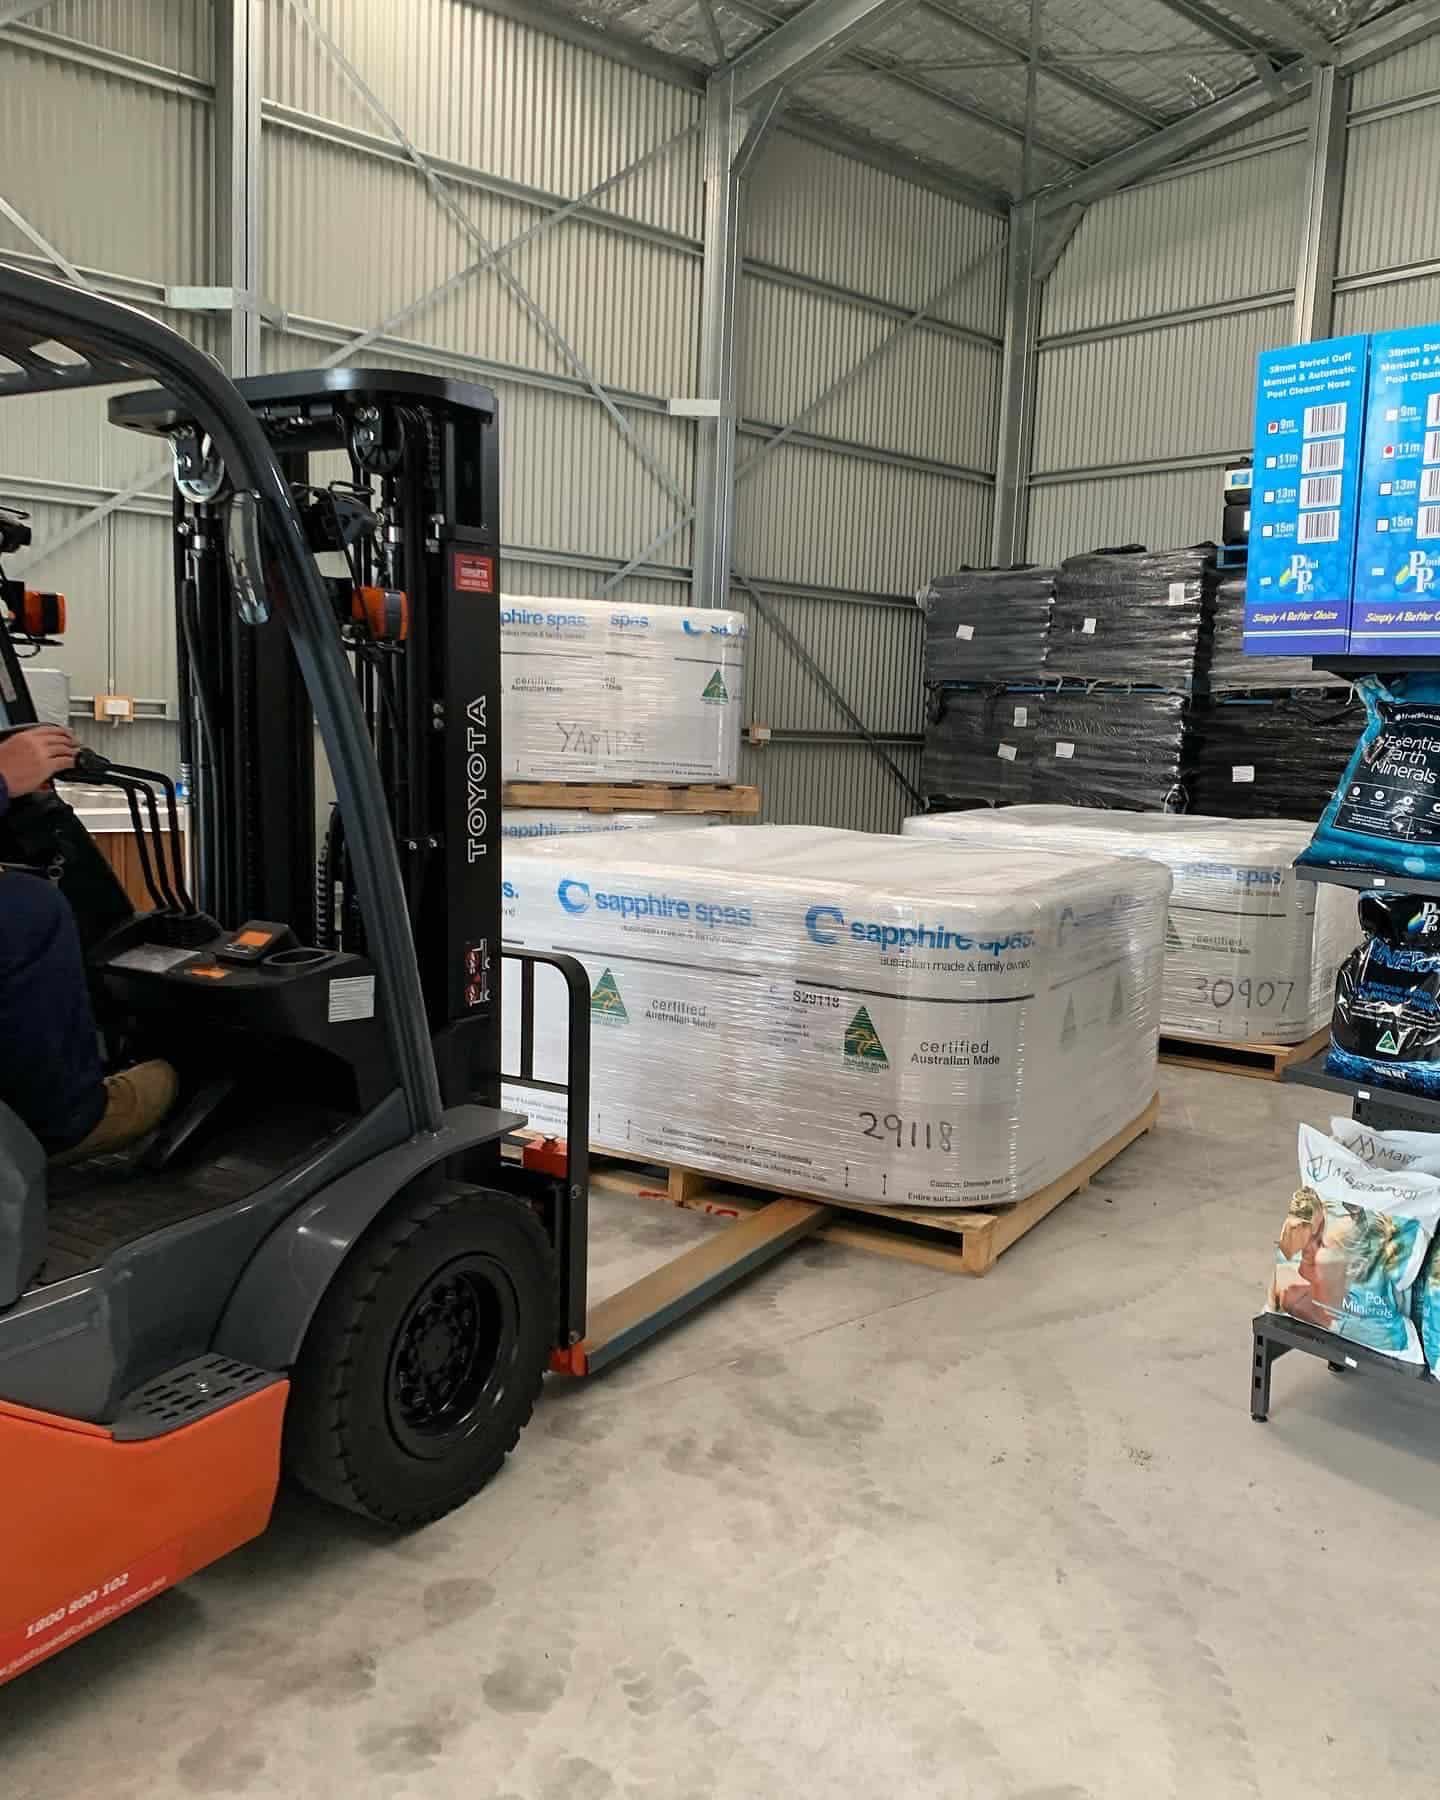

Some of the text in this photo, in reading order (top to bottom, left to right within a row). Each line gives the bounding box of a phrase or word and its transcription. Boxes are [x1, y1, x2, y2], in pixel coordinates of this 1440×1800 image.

[1299, 357, 1329, 369] Swivel
[1332, 352, 1352, 363] Cuff
[1381, 359, 1420, 372] Manual
[1423, 357, 1430, 366] &
[1264, 365, 1357, 388] Manual & Automatic
[1385, 374, 1408, 385] Pool
[1266, 380, 1351, 399] Pool Cleaner Hose
[1400, 406, 1416, 415] 9m
[1280, 419, 1295, 430] 9m
[1398, 442, 1420, 453] 11m
[1279, 453, 1298, 464] 11m
[1394, 480, 1416, 490] 13m
[1275, 522, 1295, 533] 15m
[1391, 516, 1413, 528] 15m
[1252, 609, 1338, 624] Simply A Better Choice
[1365, 612, 1395, 624] Simply
[1395, 611, 1404, 621] A
[1404, 610, 1433, 622] Better
[1385, 748, 1427, 765] arth
[466, 696, 487, 863] TOYOTA
[1371, 760, 1438, 785] Minerals
[594, 891, 690, 920] sapphire
[850, 921, 972, 952] sapphire
[932, 960, 965, 972] made
[967, 961, 975, 972] &
[977, 960, 1004, 974] family
[1194, 976, 1295, 1014] 30907
[919, 1039, 989, 1055] certified
[910, 1054, 1000, 1067] Australian Made
[858, 1111, 953, 1152] 29118
